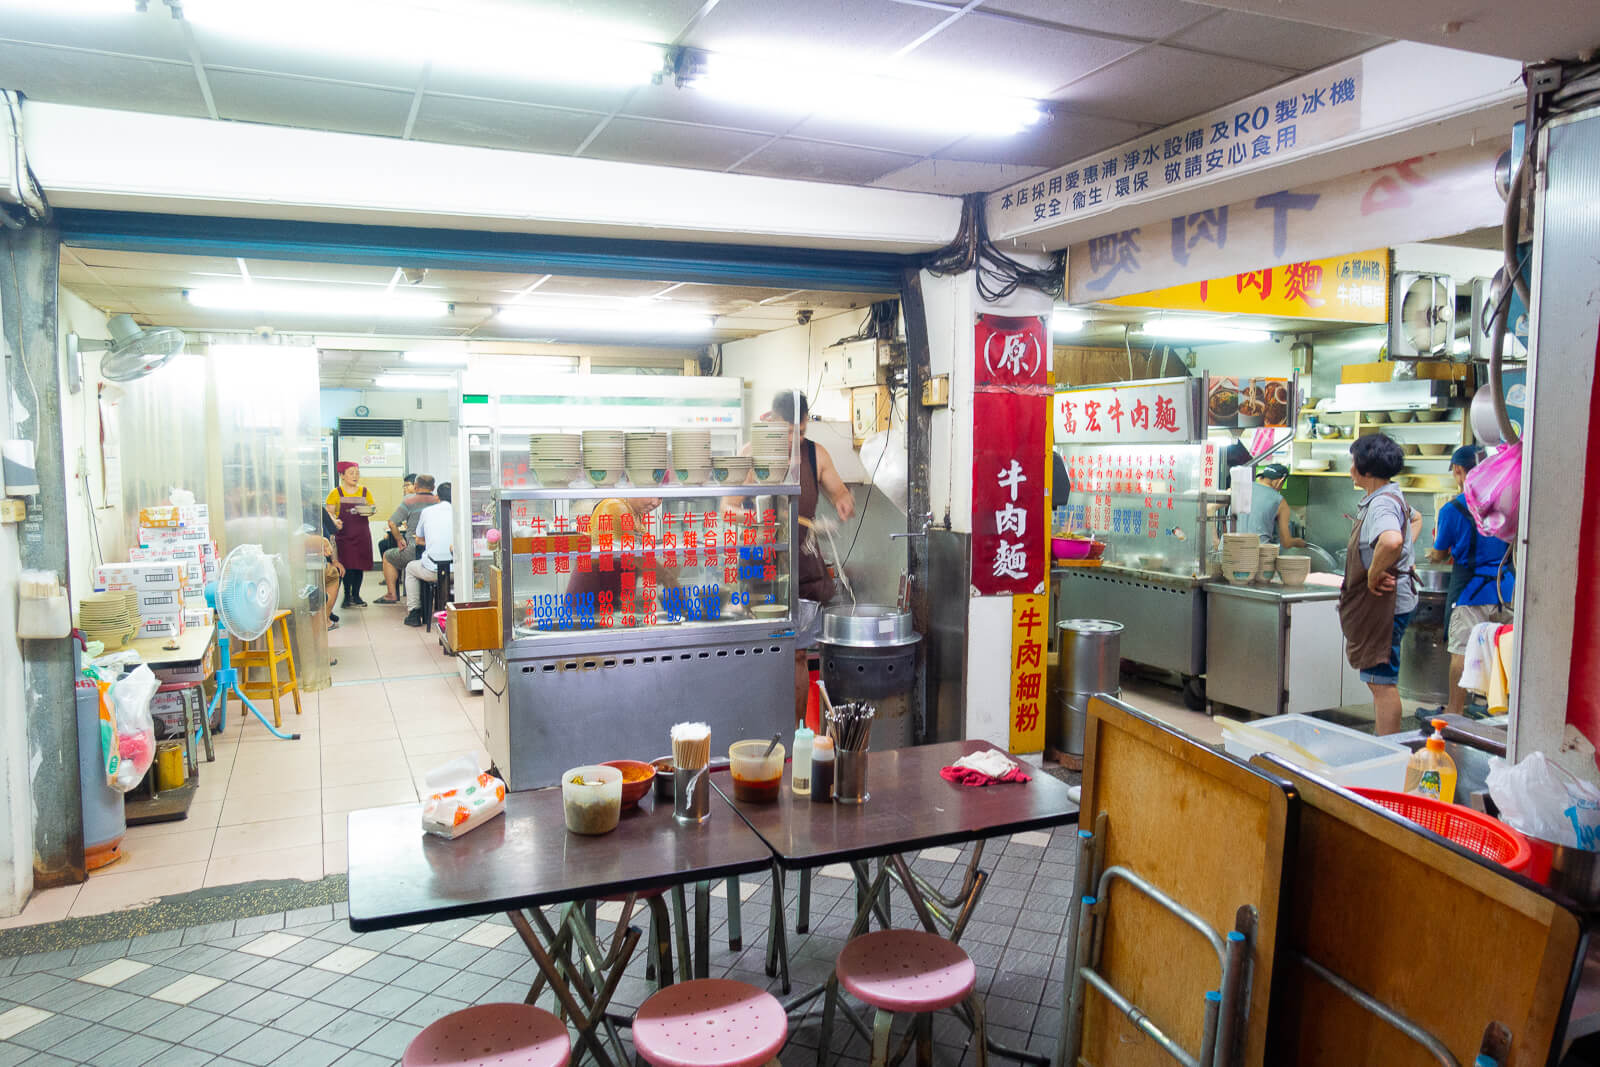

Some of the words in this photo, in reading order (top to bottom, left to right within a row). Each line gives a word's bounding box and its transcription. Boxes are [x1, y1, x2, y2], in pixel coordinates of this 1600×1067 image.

[1164, 124, 1297, 184] 敬請安心食用
[1061, 394, 1181, 435] 富宏牛肉麵
[531, 515, 548, 575] 牛肉麵
[662, 511, 677, 568] 牛肉湯
[703, 510, 718, 567] 綜合湯
[723, 510, 738, 584] 牛肉湯餃
[743, 509, 757, 546] 水餃
[762, 509, 777, 582] 各式小菜
[993, 459, 1029, 580] 牛肉麵
[533, 593, 552, 606] 110
[554, 593, 573, 606] 110
[575, 592, 594, 605] 110
[598, 590, 613, 603] 60
[620, 590, 635, 602] 60
[642, 589, 656, 600] 60
[662, 587, 680, 600] 110
[682, 585, 700, 597] 110
[702, 584, 719, 596] 110
[730, 592, 750, 605] 60
[533, 606, 552, 618] 100
[554, 606, 573, 618] 100
[575, 605, 595, 617] 100
[599, 603, 614, 616] 50
[621, 602, 635, 614] 50
[643, 601, 657, 613] 50
[683, 598, 701, 610] 100
[599, 615, 614, 628] 40
[621, 615, 635, 627] 40
[643, 614, 657, 626] 40
[1015, 607, 1042, 732] 牛肉細粉
